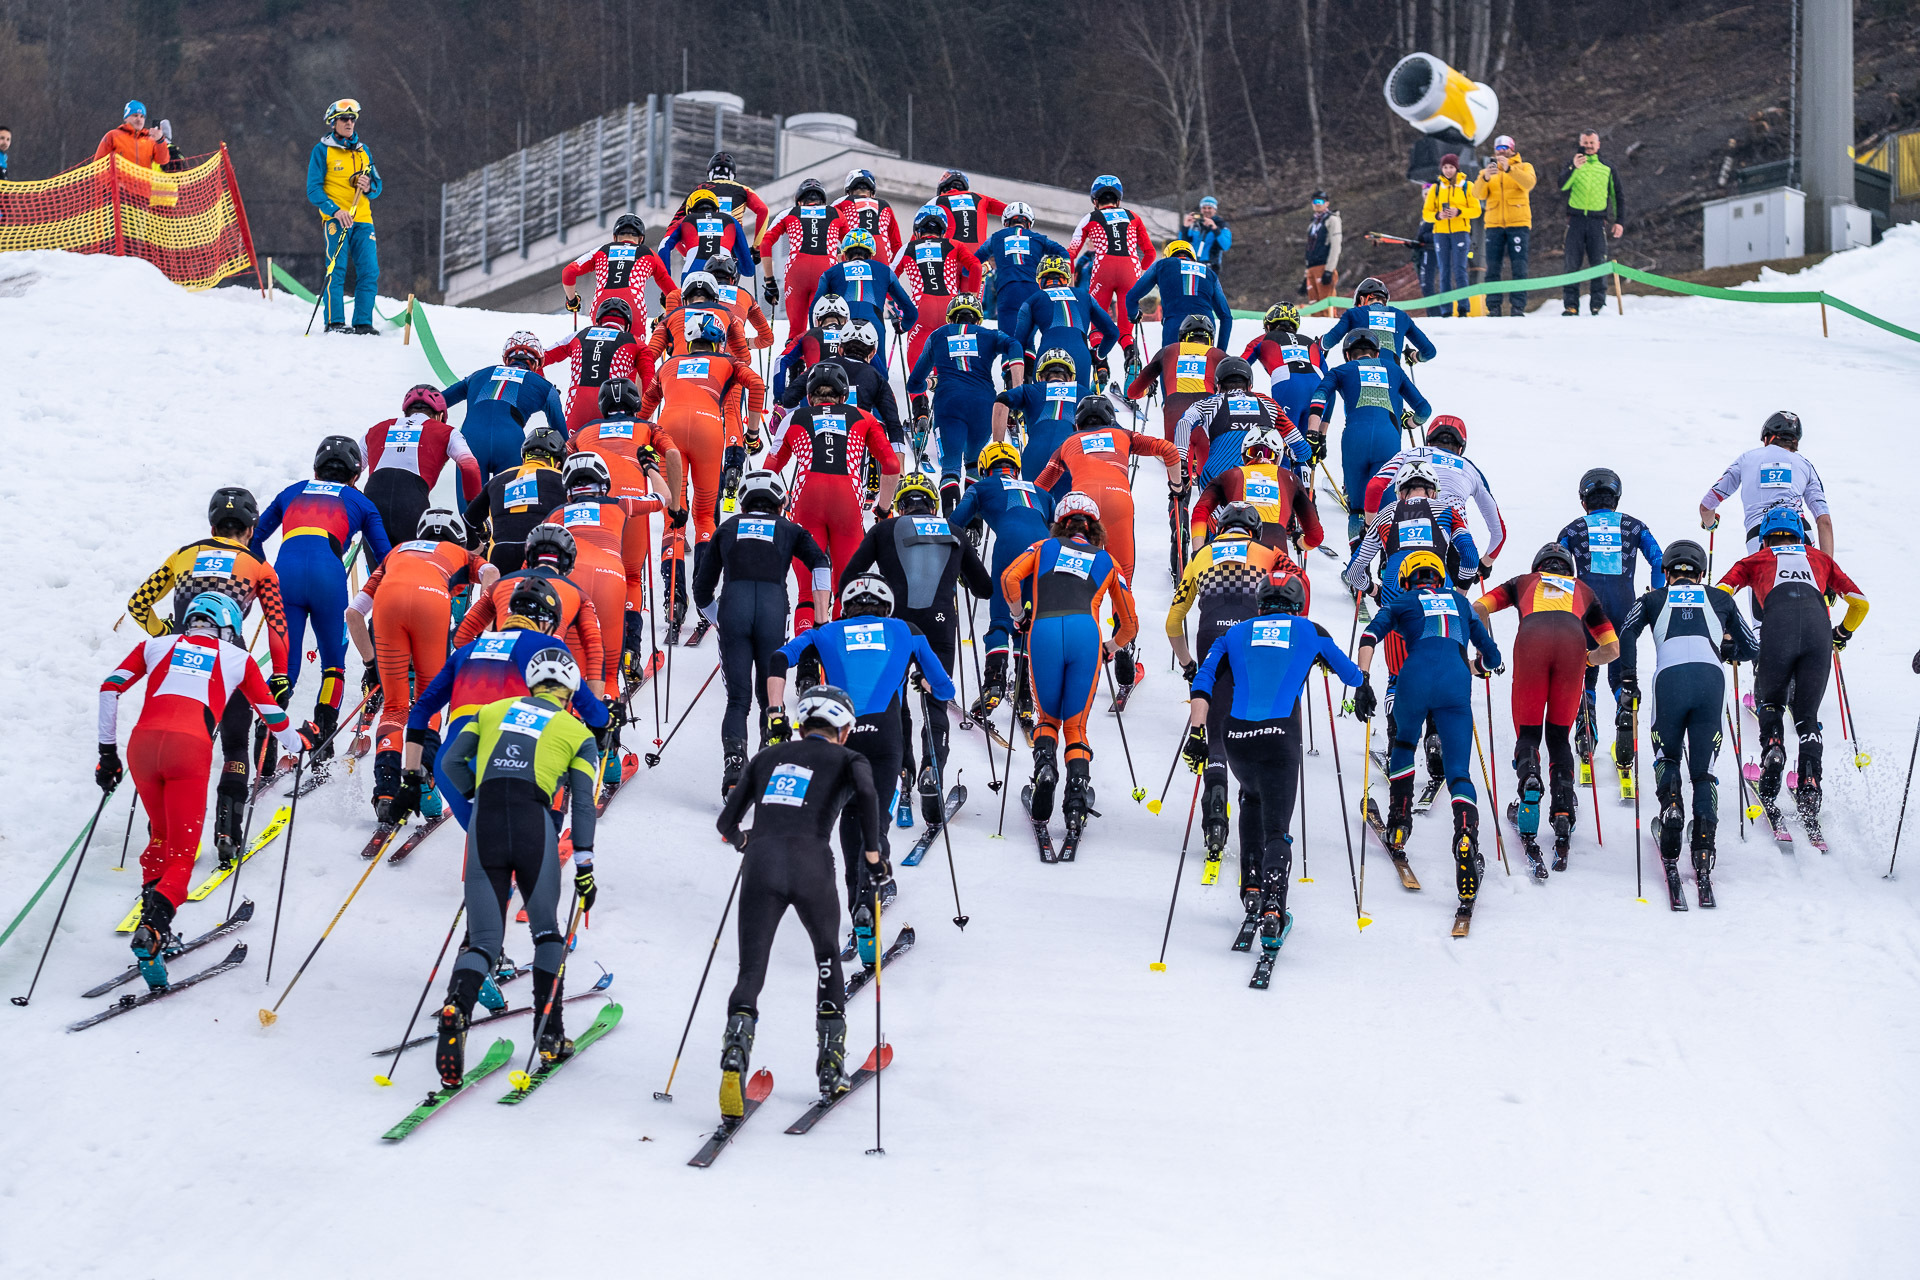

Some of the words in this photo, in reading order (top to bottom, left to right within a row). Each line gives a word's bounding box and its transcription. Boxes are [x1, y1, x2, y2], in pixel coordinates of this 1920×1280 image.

[956, 341, 970, 349] 19
[685, 364, 701, 372] 27
[1184, 362, 1198, 370] 18
[822, 419, 837, 427] 34
[1230, 422, 1259, 430] SVK
[395, 431, 411, 439] 35
[1090, 439, 1105, 447] 36
[1441, 456, 1456, 464] 39
[1769, 470, 1784, 479] 57
[512, 484, 527, 496] 41
[1254, 486, 1270, 494] 30
[573, 509, 590, 518] 38
[747, 524, 764, 532] 44
[925, 523, 940, 532] 47
[1407, 528, 1424, 537] 37
[1597, 534, 1613, 542] 33
[1221, 546, 1238, 554] 48
[204, 558, 224, 568] 45
[1066, 557, 1083, 567] 49
[1779, 570, 1811, 581] CAN
[1678, 592, 1695, 601] 42
[855, 632, 872, 642] 61
[1262, 628, 1281, 638] 59
[485, 640, 505, 650] 54
[182, 653, 203, 665] 50
[515, 711, 538, 724] 58
[1228, 727, 1286, 739] hannah.
[493, 758, 529, 768] snow
[776, 776, 797, 789] 62
